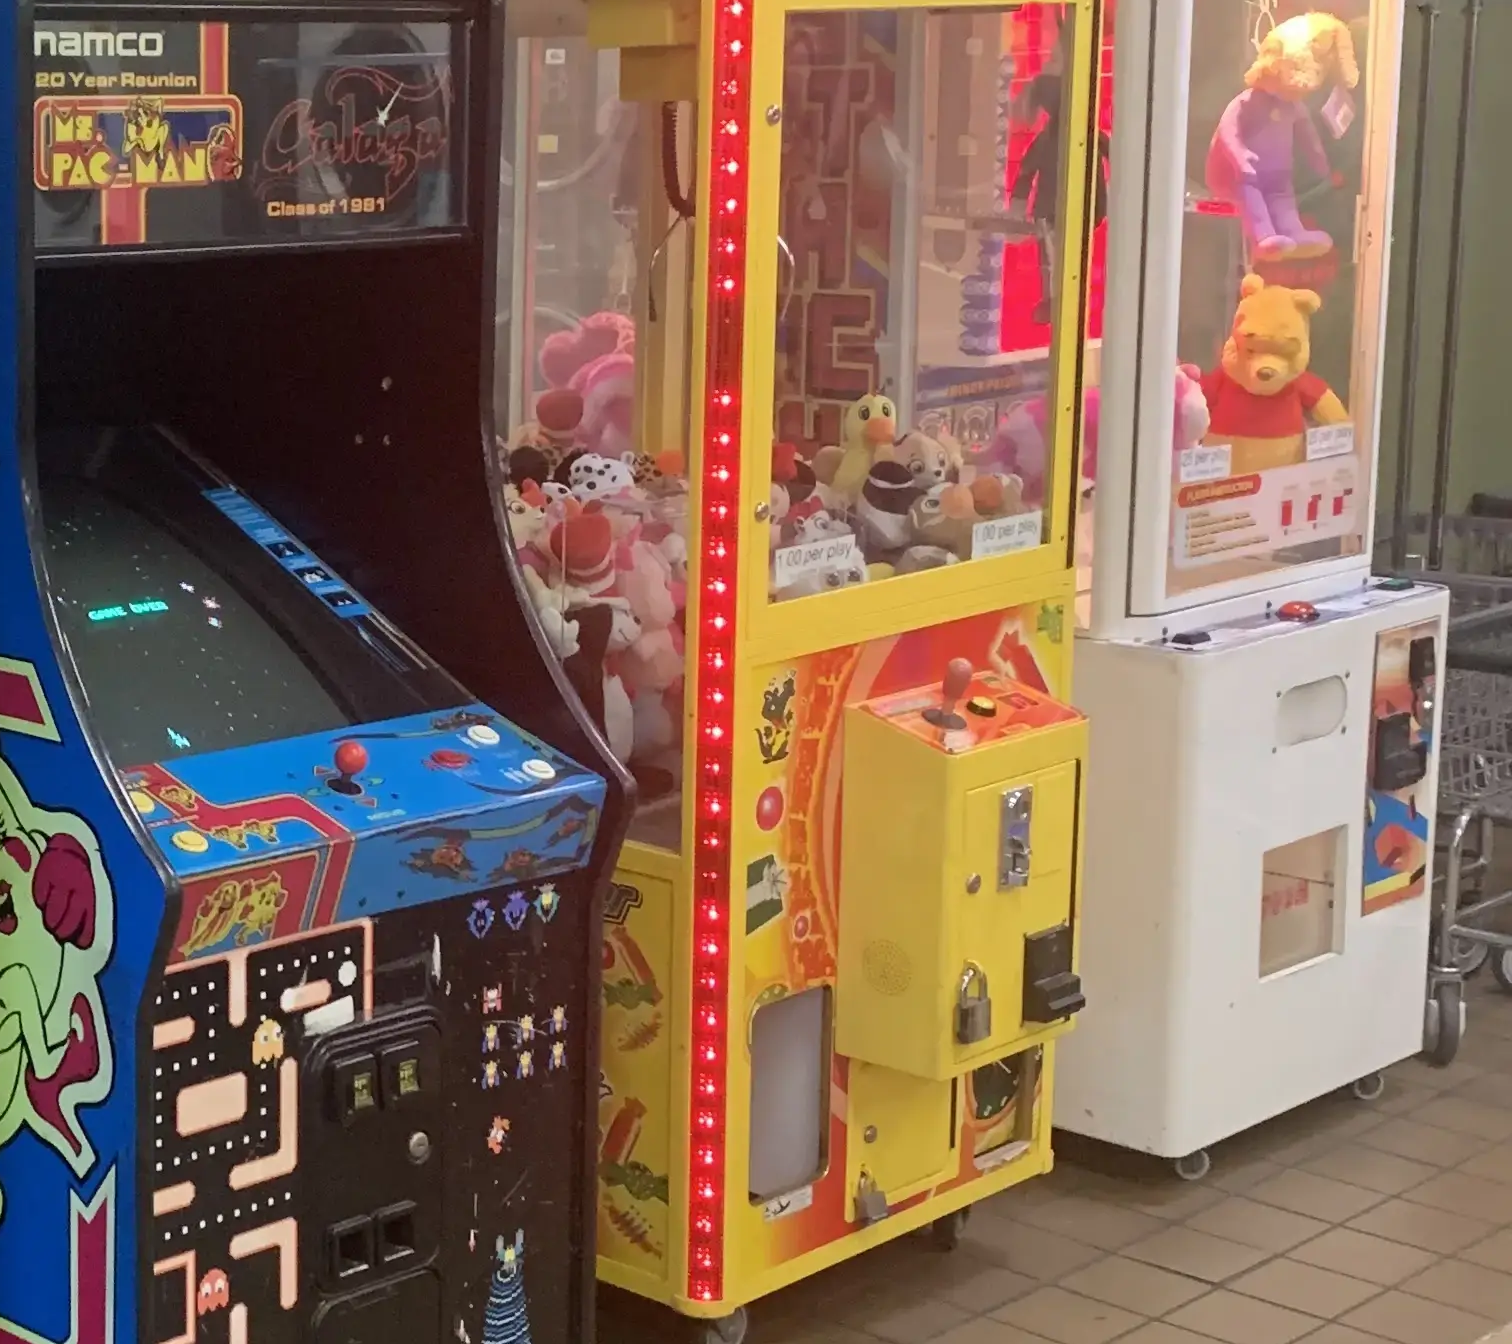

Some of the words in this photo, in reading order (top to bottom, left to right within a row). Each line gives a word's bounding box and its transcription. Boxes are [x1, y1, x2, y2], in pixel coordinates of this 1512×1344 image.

[33, 30, 164, 56] namco
[35, 71, 65, 88] 20
[68, 71, 118, 88] Year
[121, 71, 197, 89] Reunion
[52, 109, 105, 143] MS.
[262, 93, 448, 201] Galaga
[51, 148, 207, 187] PAC-MAN
[266, 200, 316, 217] Class
[318, 198, 337, 215] of
[338, 196, 385, 214] 1981
[88, 605, 128, 621] GAME
[128, 600, 169, 614] OVER
